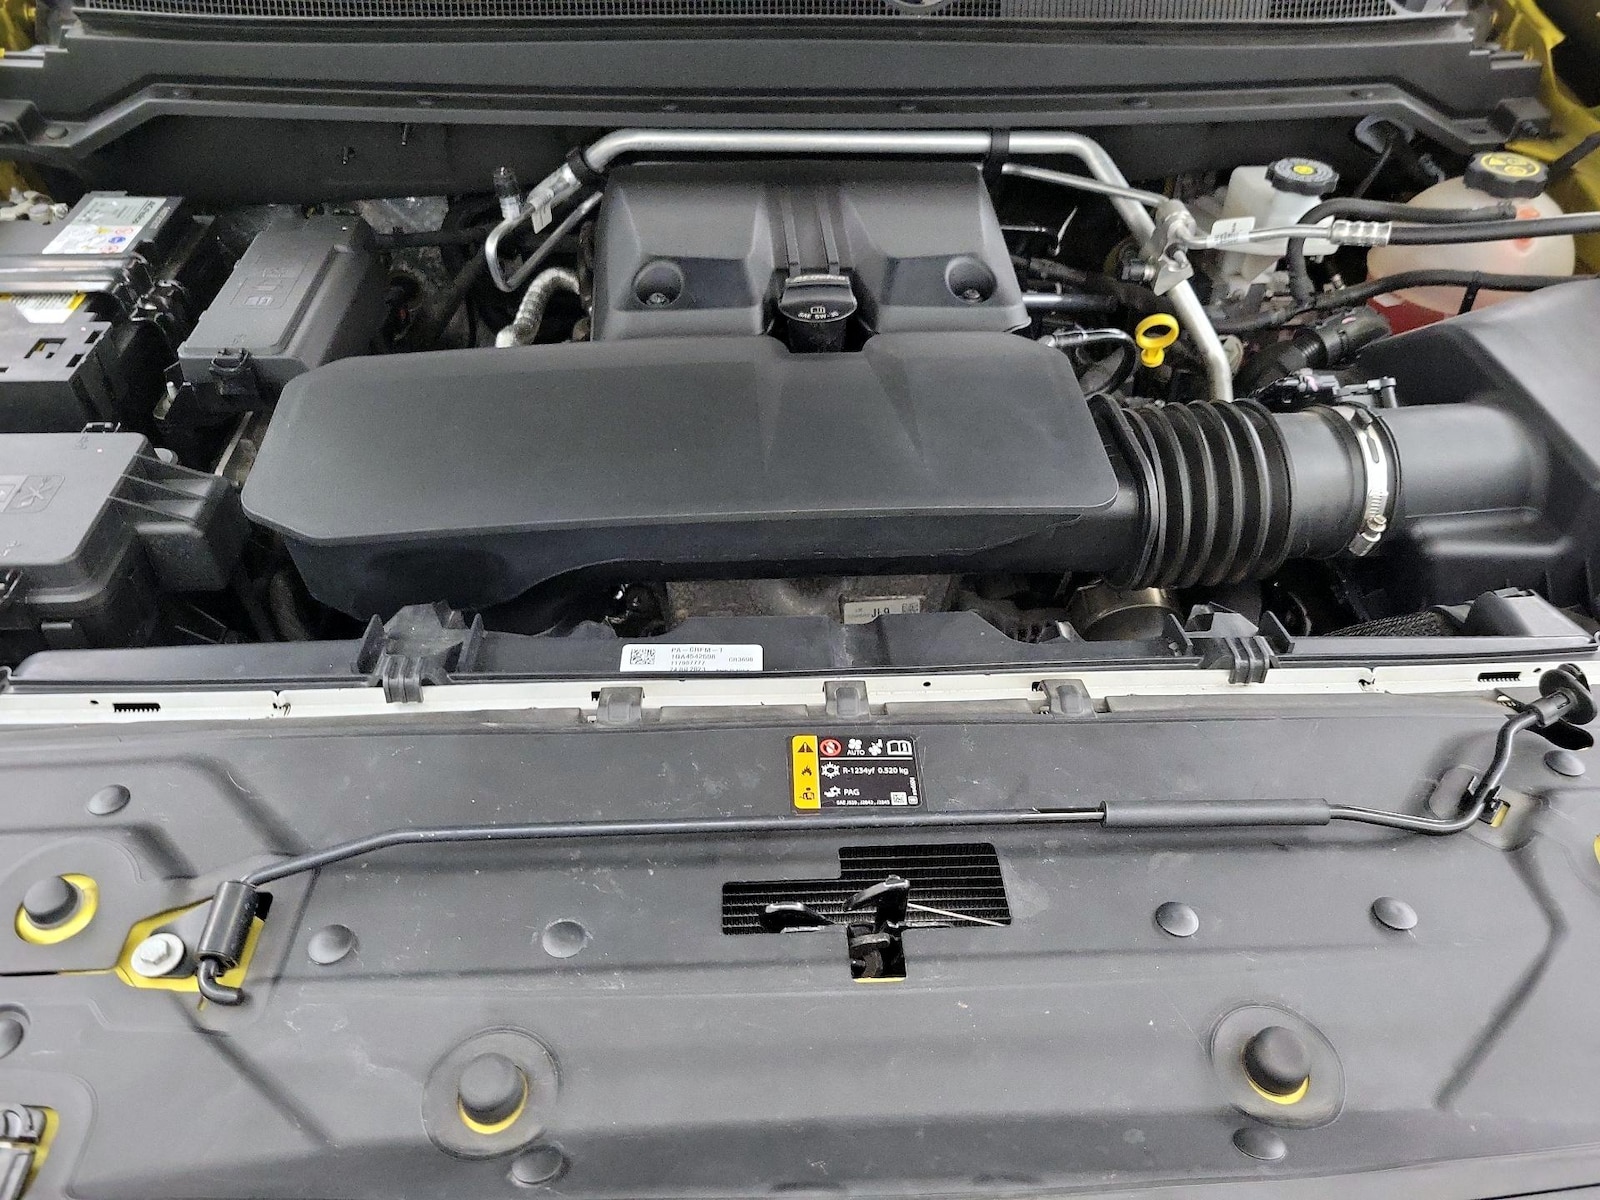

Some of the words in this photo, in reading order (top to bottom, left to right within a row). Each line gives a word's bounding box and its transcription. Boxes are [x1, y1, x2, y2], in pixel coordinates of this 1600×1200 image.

[842, 767, 875, 776] R-1234yf
[899, 767, 909, 776] kg
[843, 788, 860, 796] PAG
